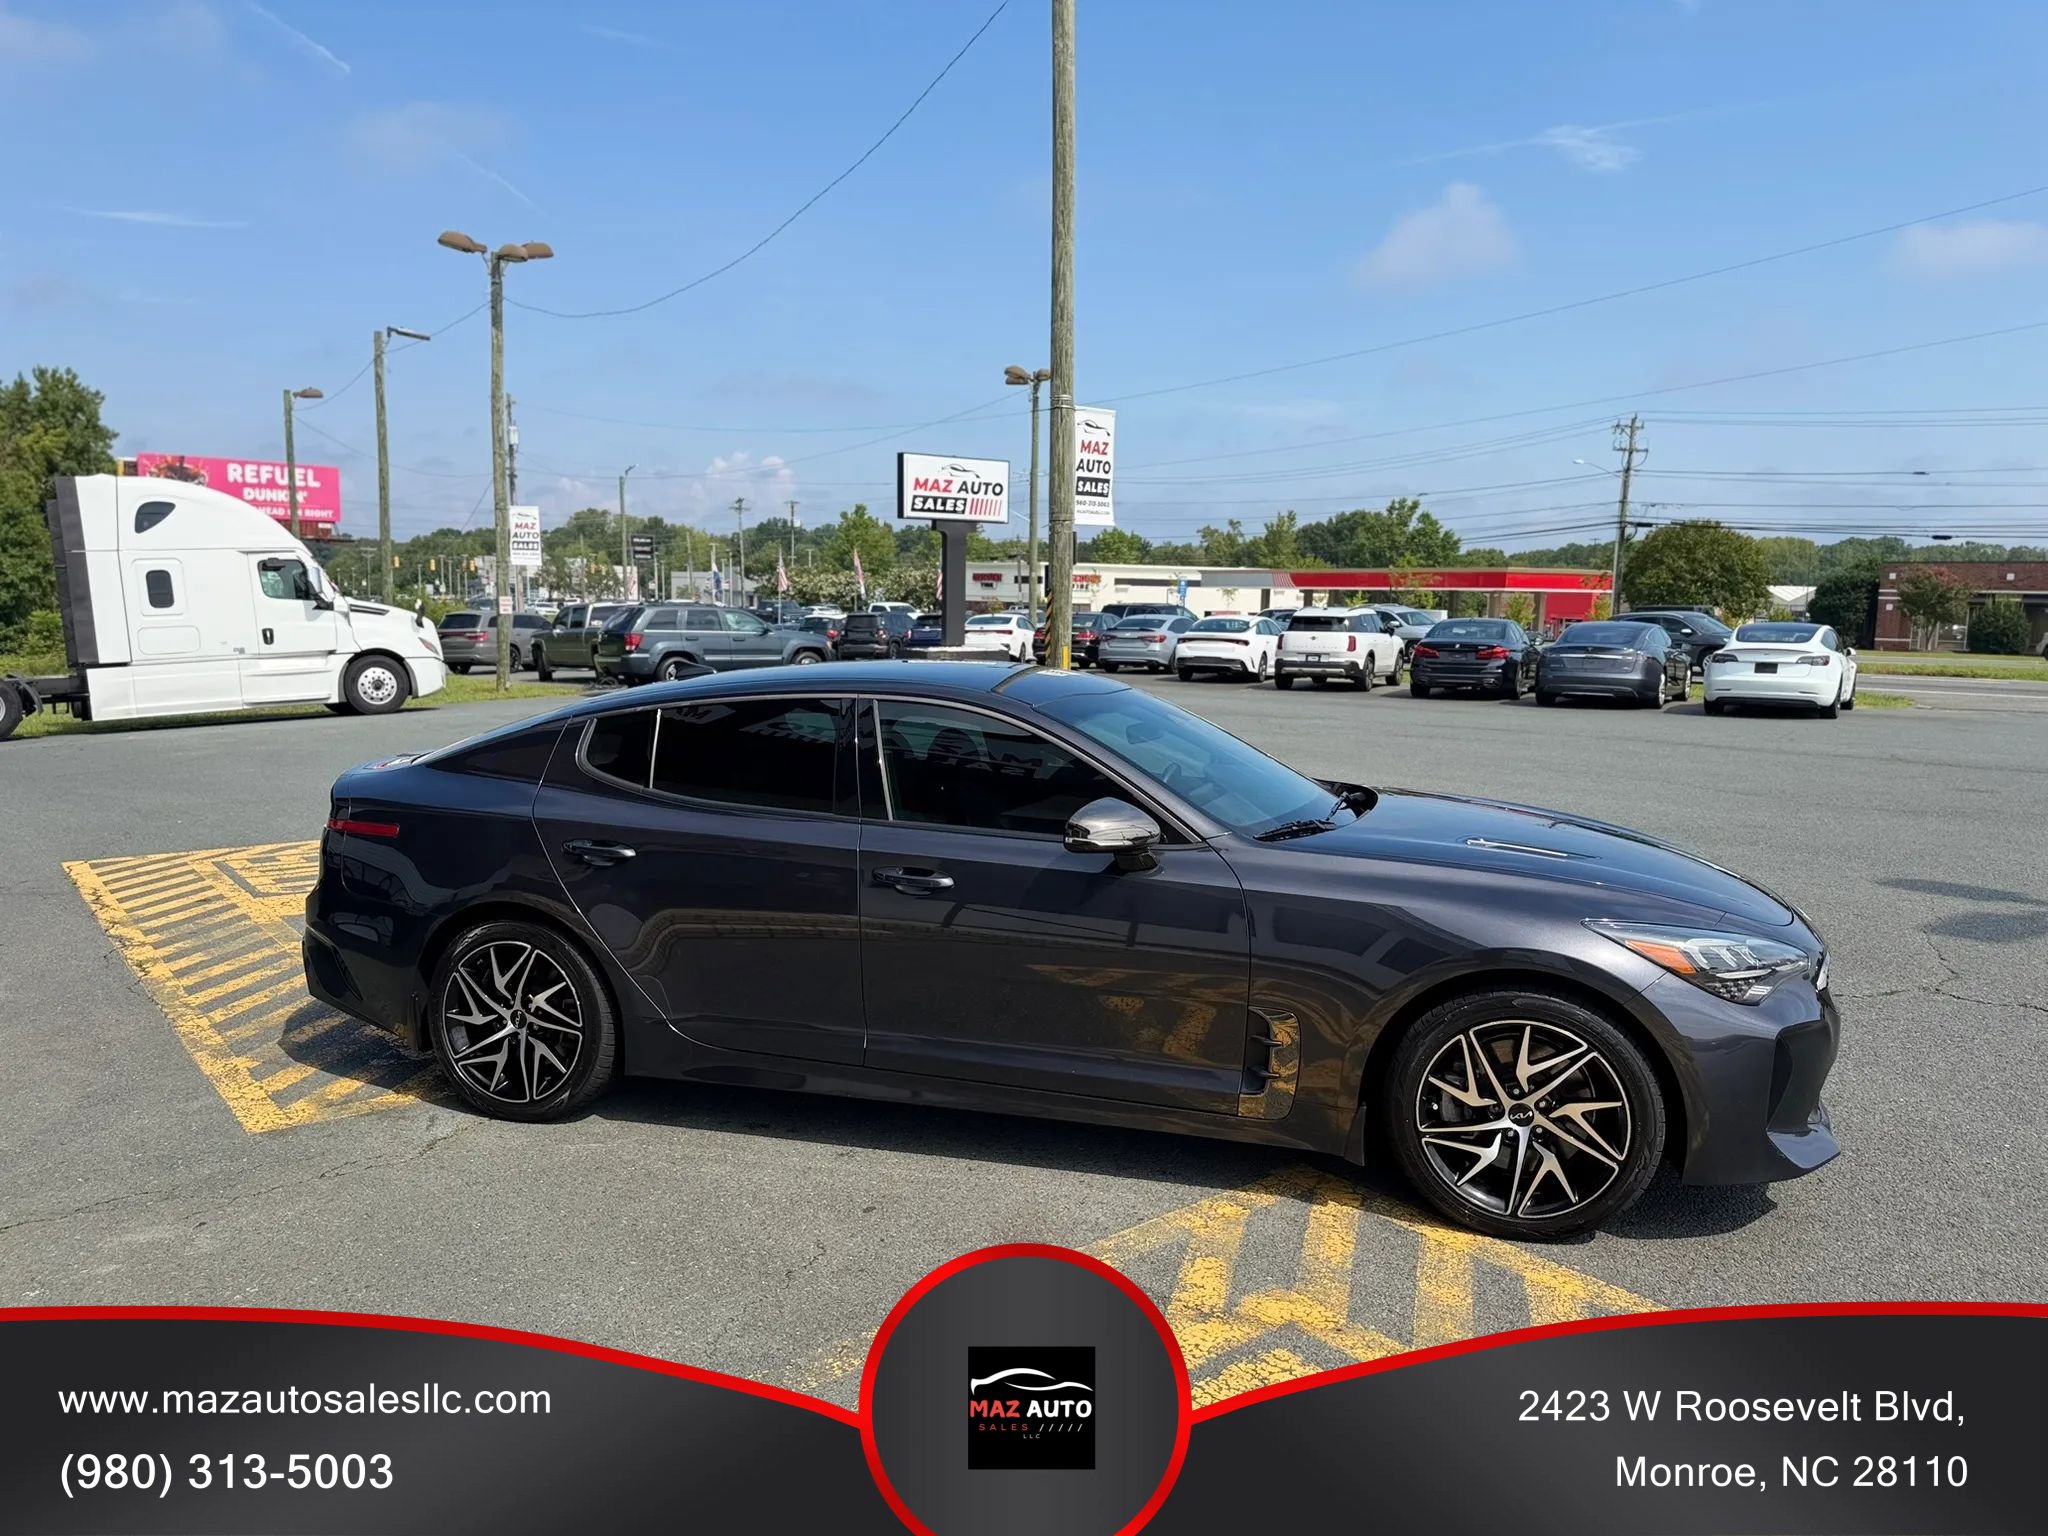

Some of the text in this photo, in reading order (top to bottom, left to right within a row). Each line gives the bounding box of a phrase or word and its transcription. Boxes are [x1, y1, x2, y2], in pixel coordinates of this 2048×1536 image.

[1080, 439, 1109, 456] MAZ
[1076, 458, 1111, 474] AUTO
[227, 463, 321, 488] REFUEL
[913, 477, 1004, 496] MAZ AUTO
[1077, 480, 1109, 495] SALES
[243, 487, 308, 503] DUNKN'
[913, 497, 965, 513] SALES
[304, 509, 334, 519] RIGHT
[514, 522, 536, 530] MAZ
[512, 531, 540, 540] AUTO
